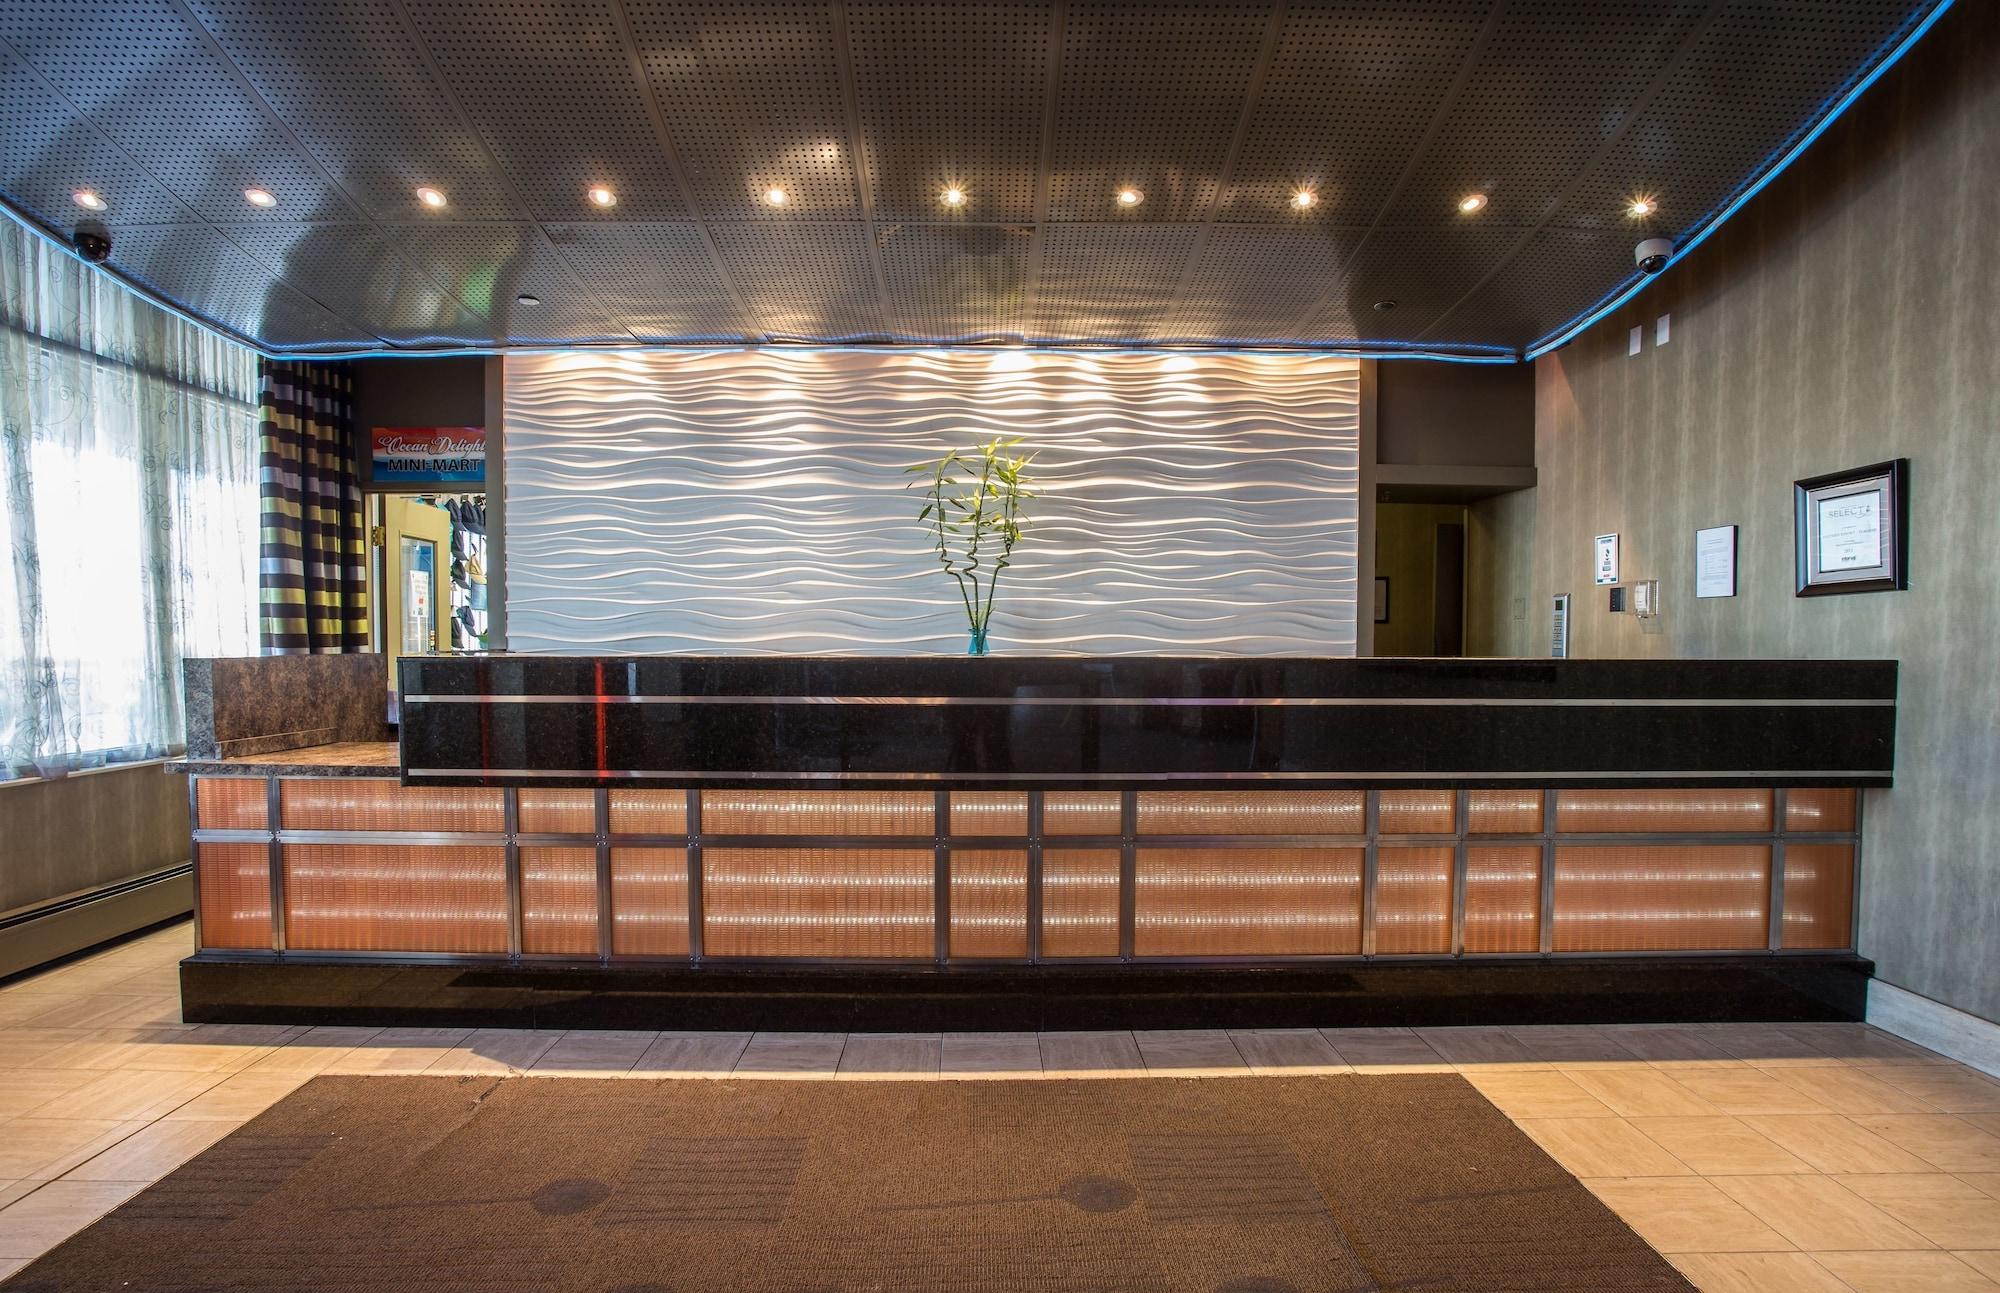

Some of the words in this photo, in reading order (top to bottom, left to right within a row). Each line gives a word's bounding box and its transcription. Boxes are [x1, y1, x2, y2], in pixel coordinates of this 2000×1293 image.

[378, 436, 428, 456] Ocean
[429, 436, 486, 458] Delight
[388, 458, 481, 472] MINI-MART
[1828, 505, 1862, 518] SELECT
